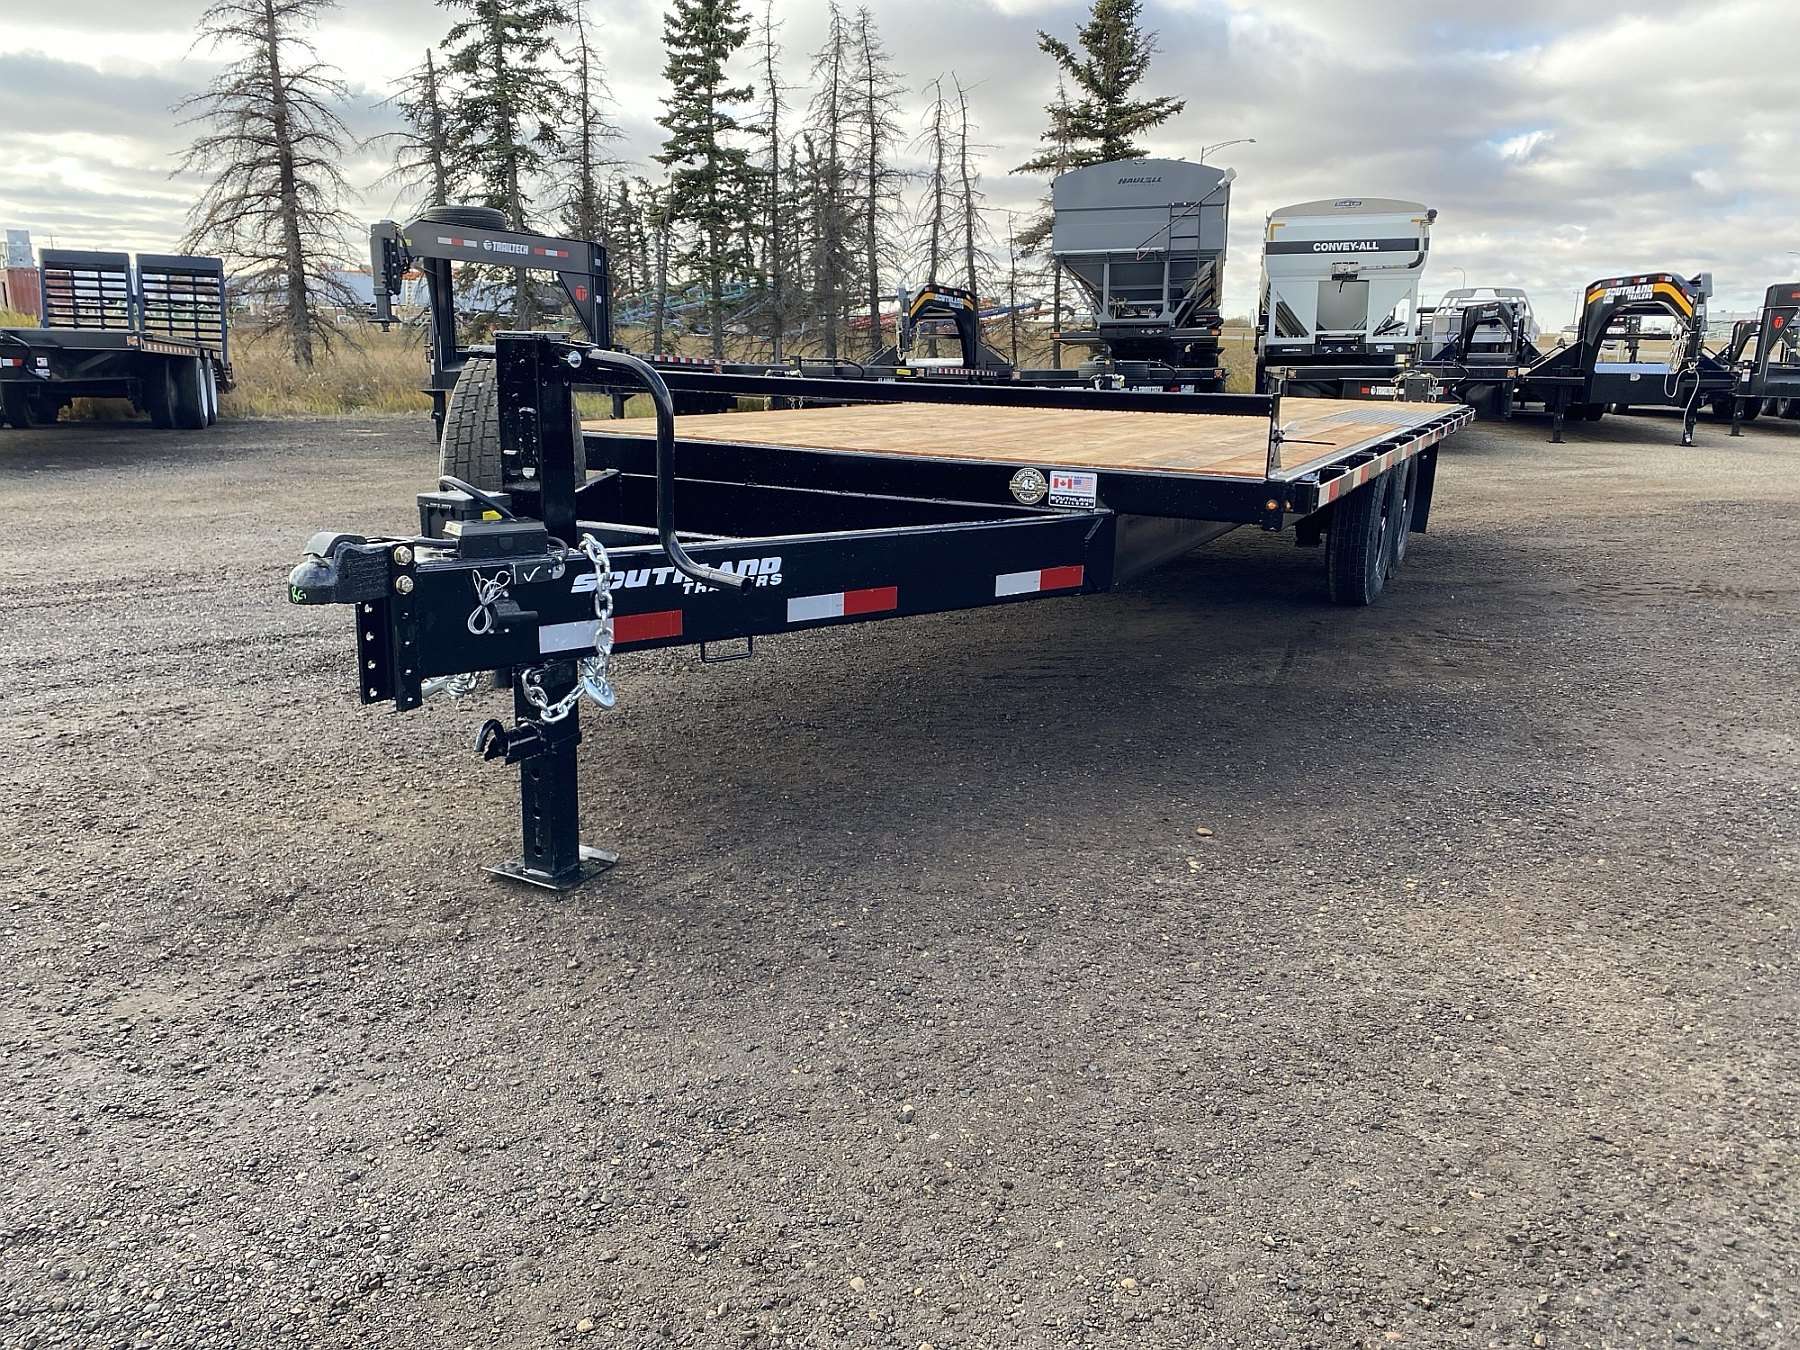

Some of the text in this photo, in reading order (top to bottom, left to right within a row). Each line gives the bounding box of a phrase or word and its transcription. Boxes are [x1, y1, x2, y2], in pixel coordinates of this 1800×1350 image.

[1313, 241, 1379, 251] CONVEY-ALL
[1606, 284, 1654, 296] SOUTHLAND
[1021, 479, 1036, 490] 45
